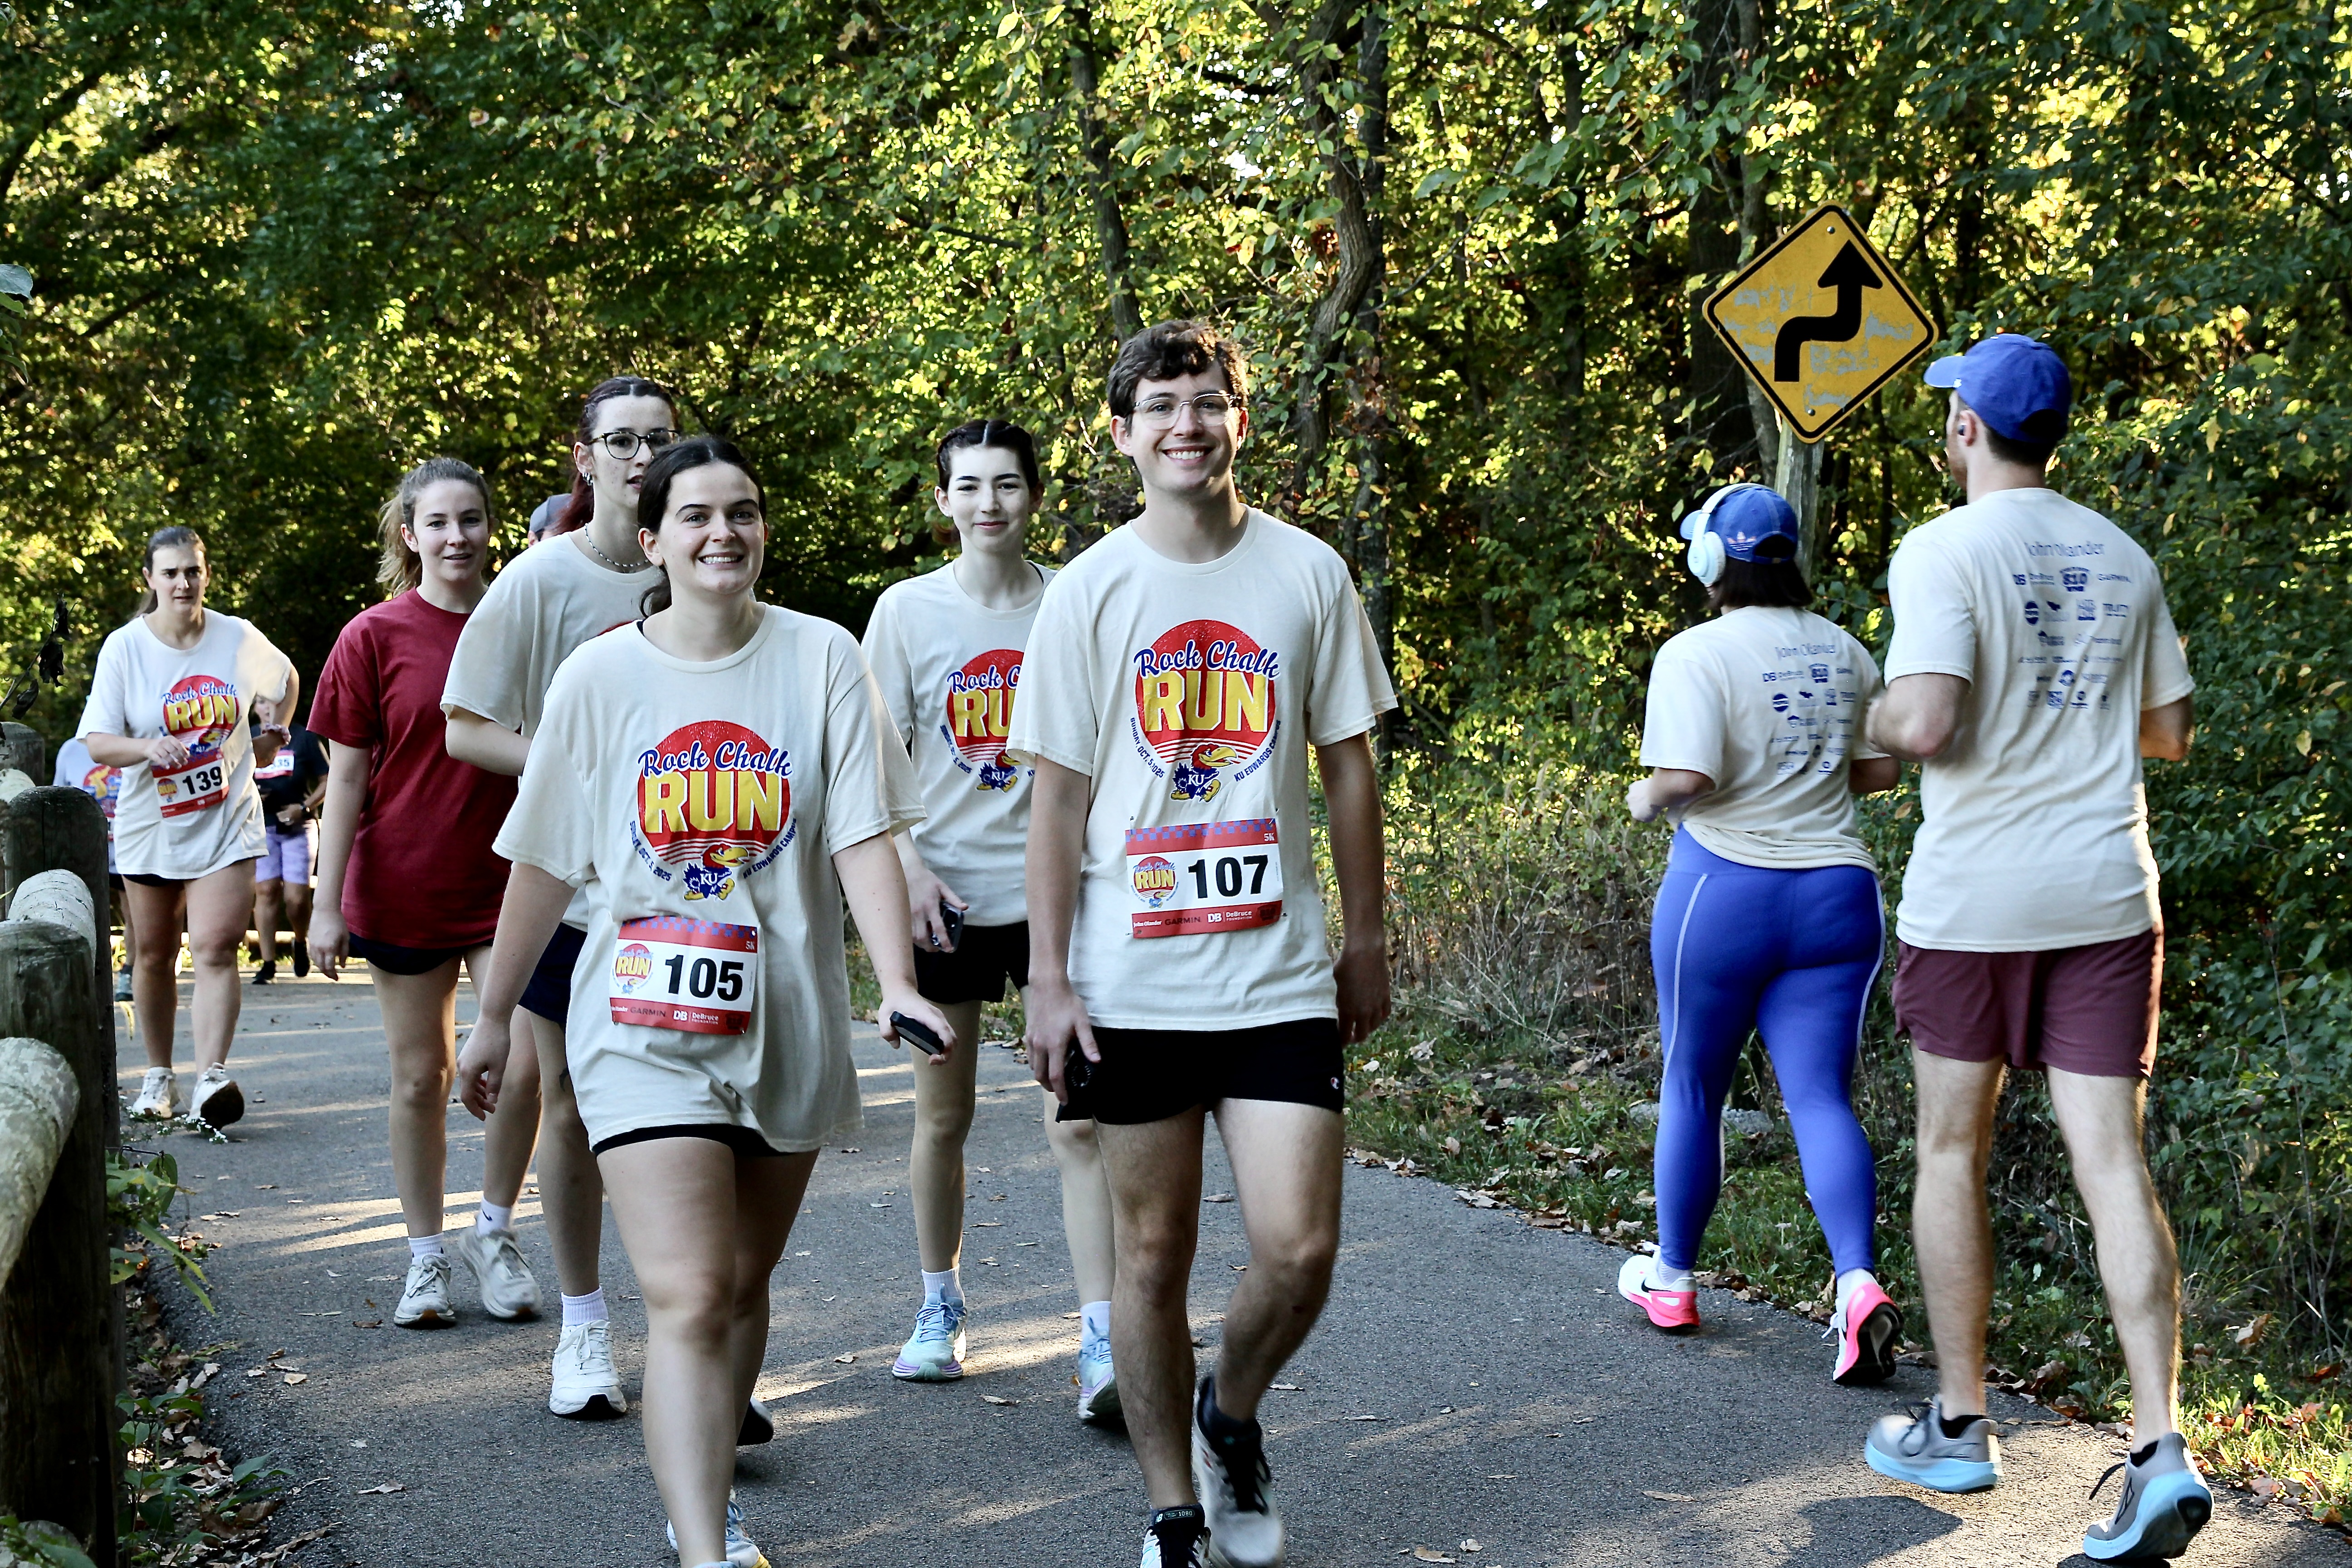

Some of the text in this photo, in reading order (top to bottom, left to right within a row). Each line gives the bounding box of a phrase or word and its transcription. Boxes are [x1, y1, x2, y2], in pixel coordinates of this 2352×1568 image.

[1134, 640, 1280, 679] Rock Chalk
[947, 666, 1002, 694] Rock
[162, 681, 237, 705] Rock Chalk
[1142, 671, 1269, 732] RUN
[167, 695, 237, 731] RUN
[953, 689, 1015, 737] RU
[638, 741, 793, 778] Rock Chalk
[1137, 746, 1150, 762] OCT.
[1234, 771, 1245, 782] KU
[1244, 748, 1272, 776] EDWARDS
[182, 766, 222, 794] 139
[1188, 774, 1204, 785] KU
[644, 770, 782, 833] RUN
[1264, 833, 1274, 841] 5K
[752, 845, 783, 872] EDWARDS
[653, 867, 672, 881] 2025
[700, 872, 719, 885] KU
[1135, 870, 1174, 889] RUN
[1188, 854, 1269, 899] 107
[1164, 916, 1201, 926] GARMIN
[1207, 912, 1222, 923] DB
[616, 956, 651, 976] RUN
[665, 954, 744, 1001] 105
[631, 1007, 666, 1017] GARMIN
[673, 1010, 688, 1021] DB
[692, 1012, 719, 1021] DeBruce
